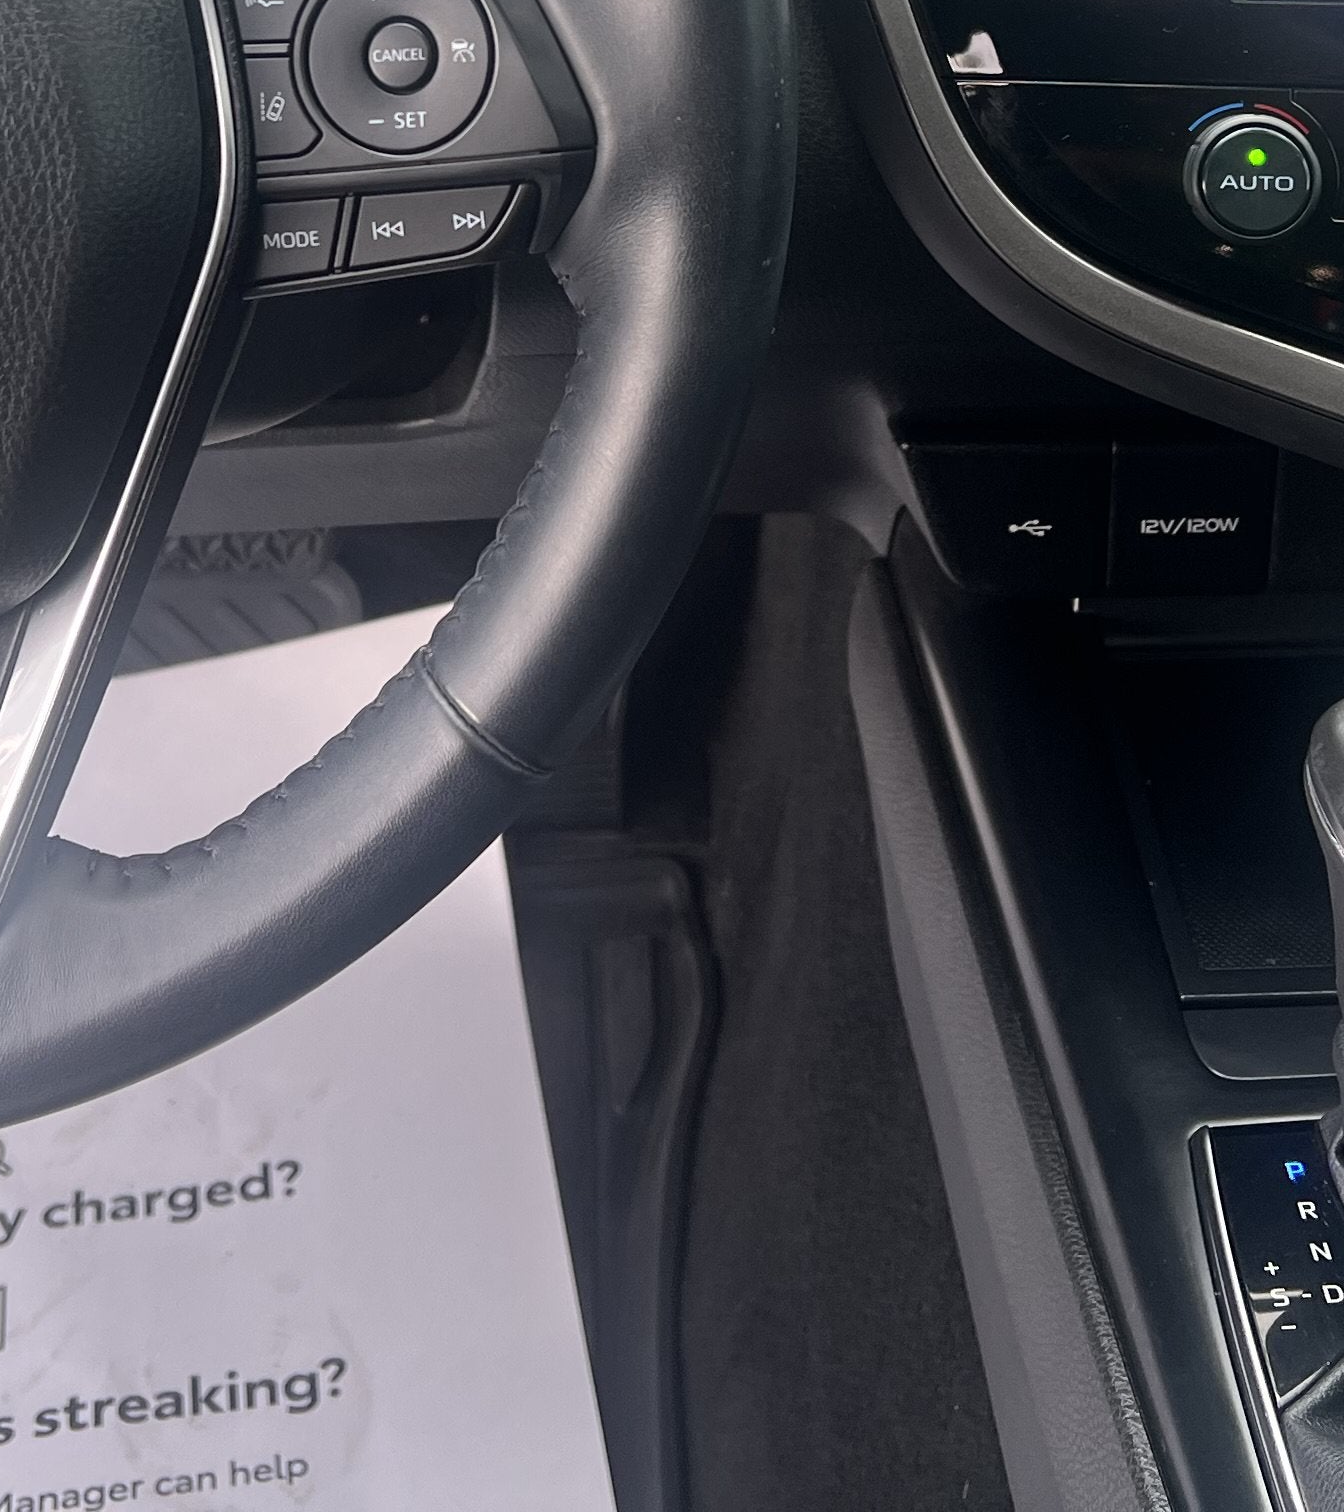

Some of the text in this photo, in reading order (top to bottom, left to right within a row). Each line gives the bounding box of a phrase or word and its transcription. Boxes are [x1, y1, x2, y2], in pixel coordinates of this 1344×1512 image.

[372, 46, 427, 63] CANCEL
[394, 111, 427, 129] SET
[1220, 174, 1295, 192] AUTO
[263, 230, 321, 251] MODE
[1140, 517, 1240, 535] 12V/120W
[1284, 1161, 1306, 1182] P
[41, 1159, 303, 1231] charged?
[1297, 1201, 1319, 1220] R
[1309, 1242, 1333, 1262] N
[1270, 1285, 1344, 1308] S D
[33, 1356, 348, 1439] streaking?
[155, 1469, 218, 1497] can
[229, 1454, 310, 1492] help
